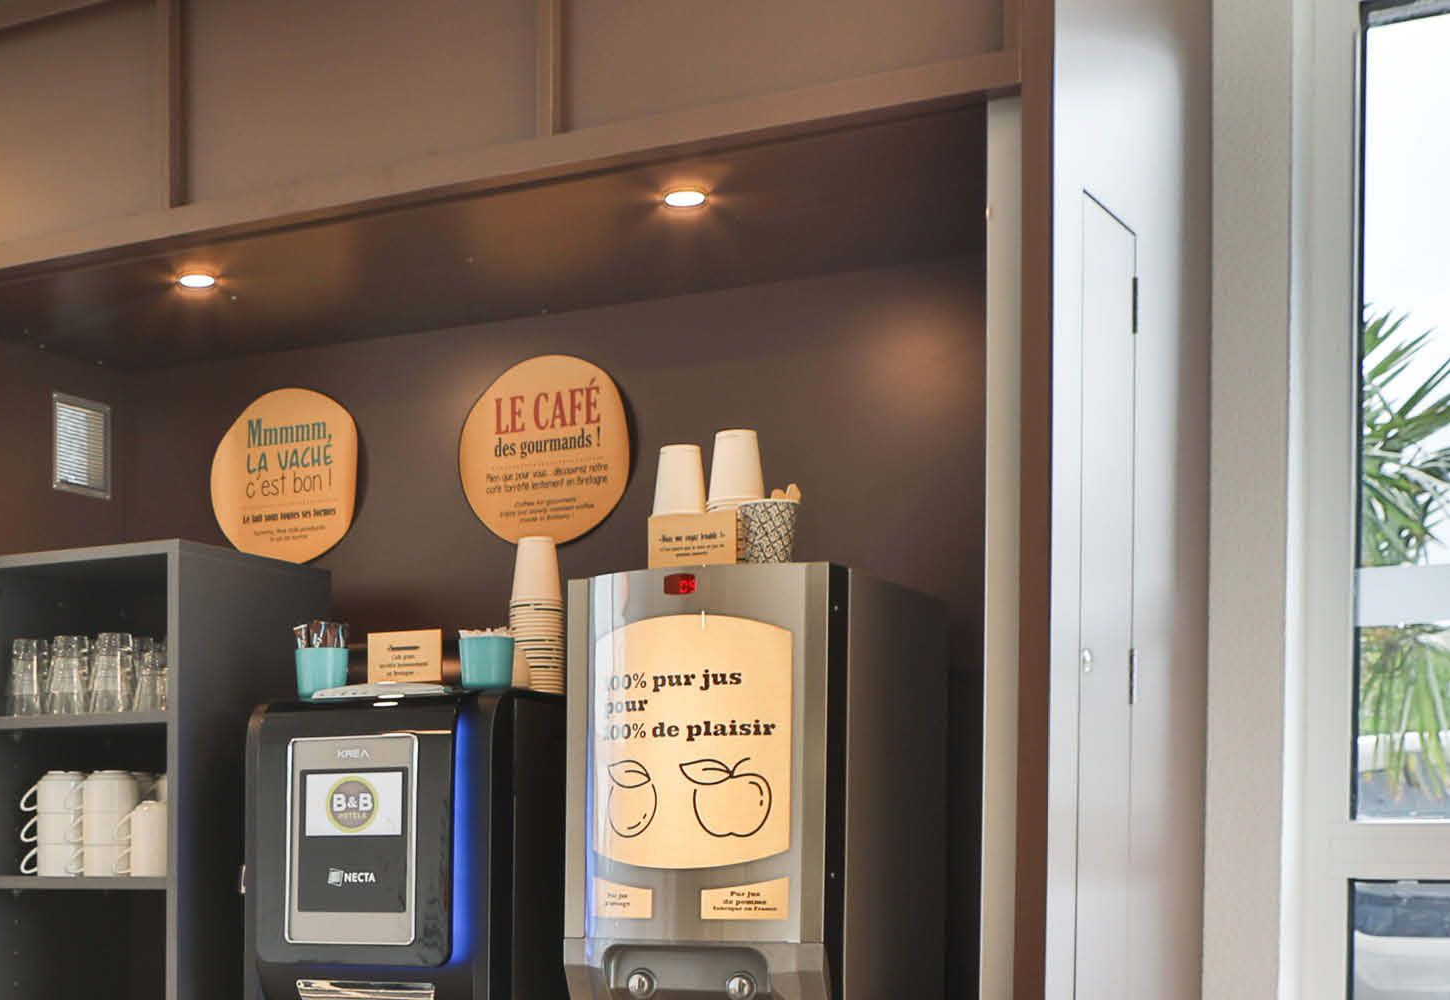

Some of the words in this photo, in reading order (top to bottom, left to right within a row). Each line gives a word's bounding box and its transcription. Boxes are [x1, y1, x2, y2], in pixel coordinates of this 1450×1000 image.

[494, 395, 525, 435] LE
[534, 376, 601, 430] CAFÉ
[494, 437, 517, 458] des
[520, 427, 592, 458] gourmands
[246, 451, 269, 474] LA
[277, 444, 333, 470] VACHE
[246, 471, 287, 498] c'est
[293, 471, 323, 494] bon
[607, 672, 647, 692] 00%
[652, 673, 696, 693] pur
[700, 669, 743, 691] jus
[605, 722, 647, 741] 00%
[652, 722, 680, 738] de
[686, 719, 777, 742] plaisir
[333, 793, 373, 813] B&B
[344, 871, 376, 883] NECTA
